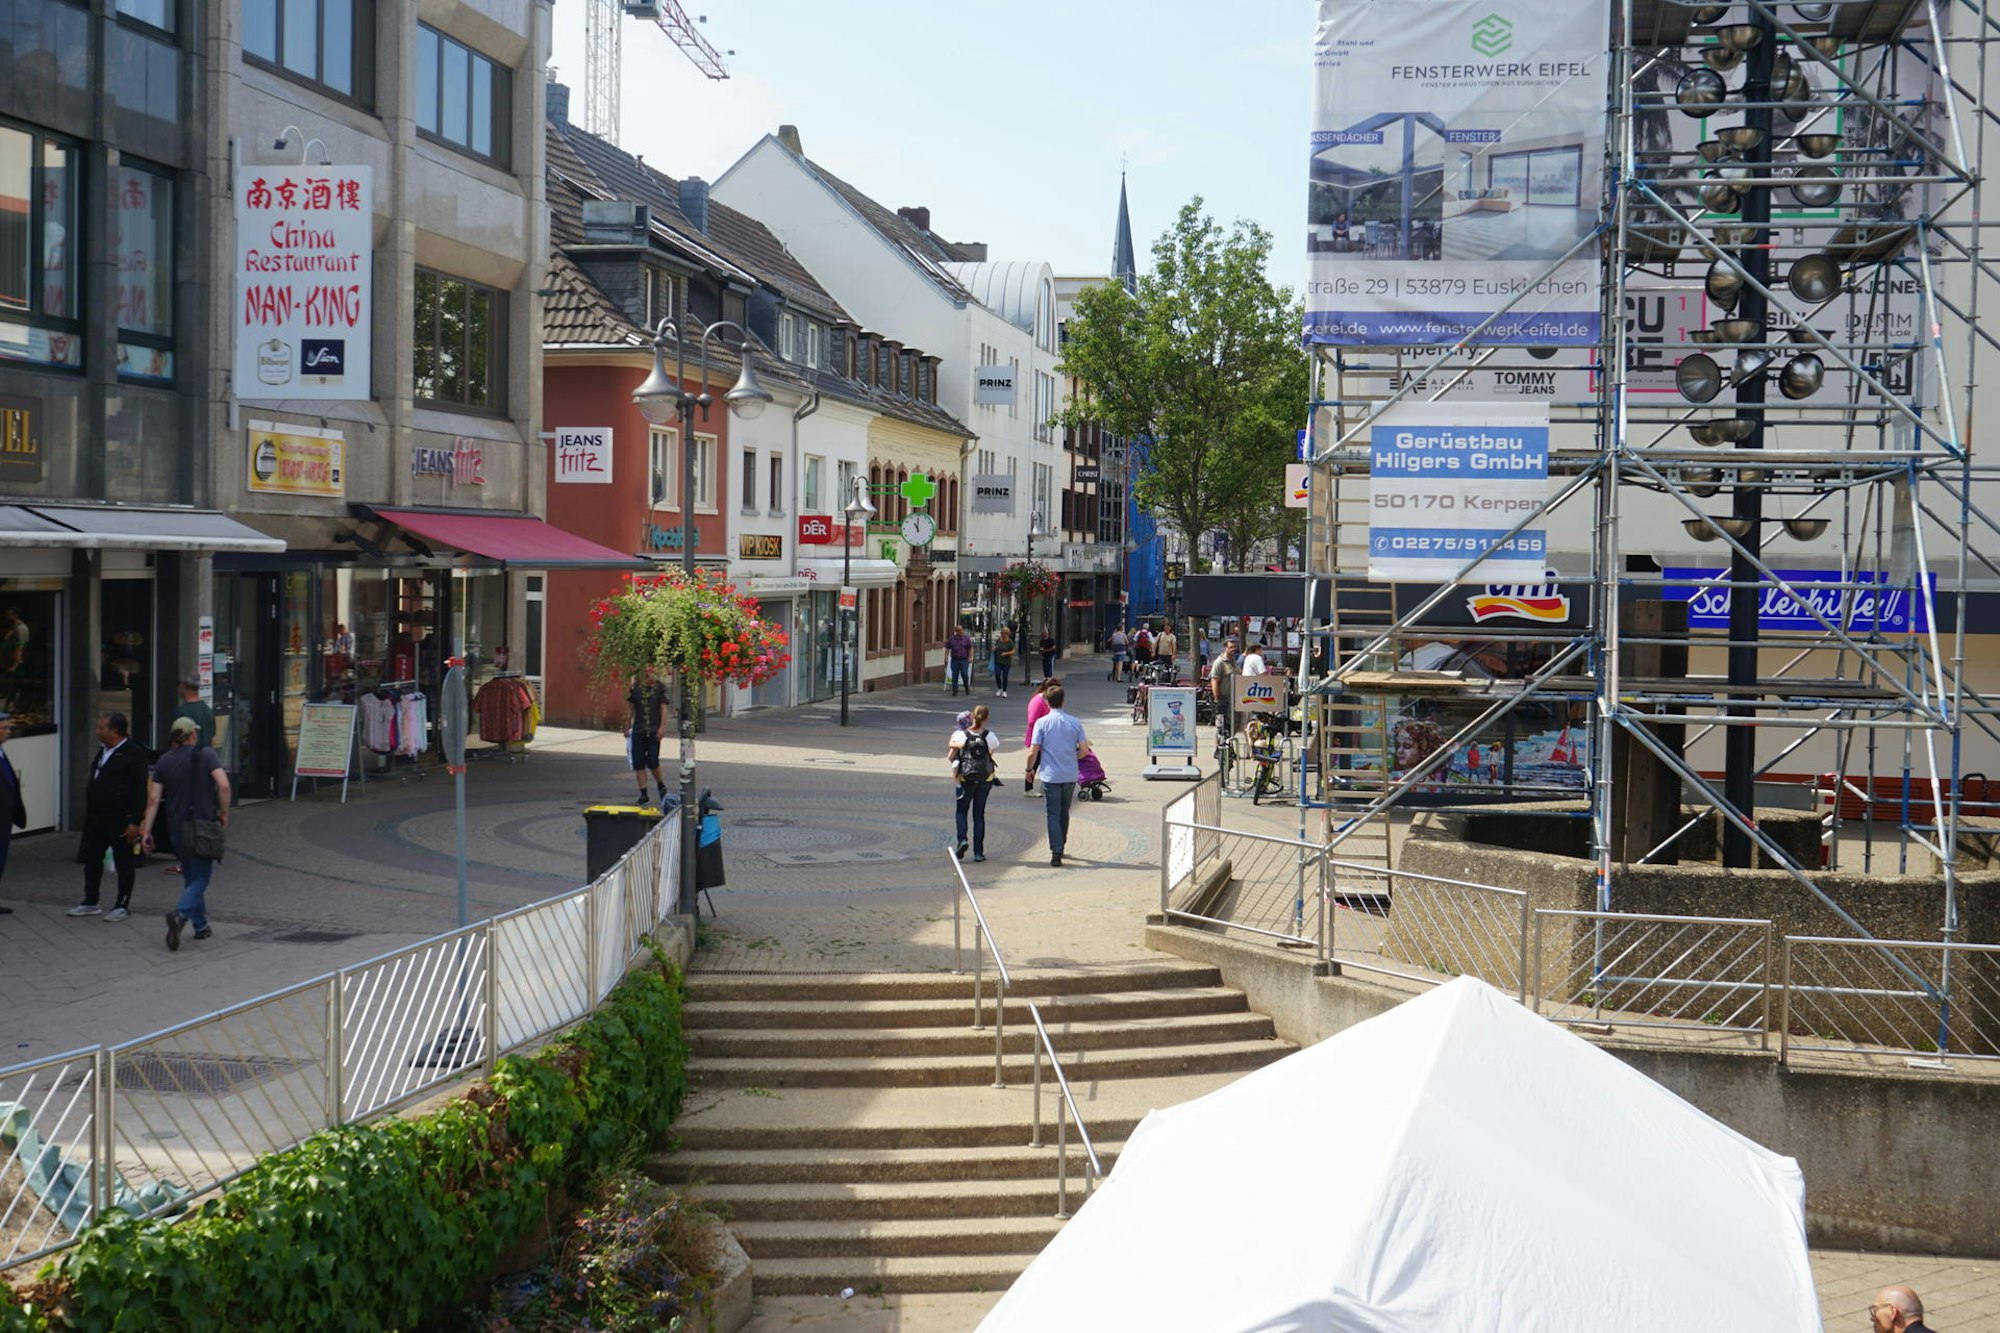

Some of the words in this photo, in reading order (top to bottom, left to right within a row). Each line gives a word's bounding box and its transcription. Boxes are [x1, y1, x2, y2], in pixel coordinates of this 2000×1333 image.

[1391, 63, 1532, 79] FENSTERWERK
[1539, 62, 1591, 76] EIFEL
[1449, 132, 1496, 141] FENSTER
[245, 177, 361, 211] 南京酒樓
[270, 219, 335, 249] China
[245, 249, 360, 272] Restaurant
[1365, 279, 1388, 295] 29
[1406, 279, 1466, 295] 53879
[1379, 321, 1588, 337] www.fenstewerk-eifel.de
[979, 378, 1012, 387] PRINZ
[1494, 372, 1556, 385] TOMMY
[1518, 385, 1556, 395] JEANS
[559, 434, 602, 448] JEANS
[1396, 432, 1523, 450] Gerüstbau
[559, 447, 604, 475] fritz
[1375, 452, 1460, 472] Hilgers
[1470, 453, 1543, 470] GmbH
[976, 487, 1009, 496] PRINZ
[1374, 494, 1455, 509] 50170
[1464, 495, 1544, 512] Kerpen
[802, 523, 828, 536] DER
[740, 535, 755, 555] VIP
[755, 535, 781, 555] KIOSK
[1247, 682, 1273, 697] dm
